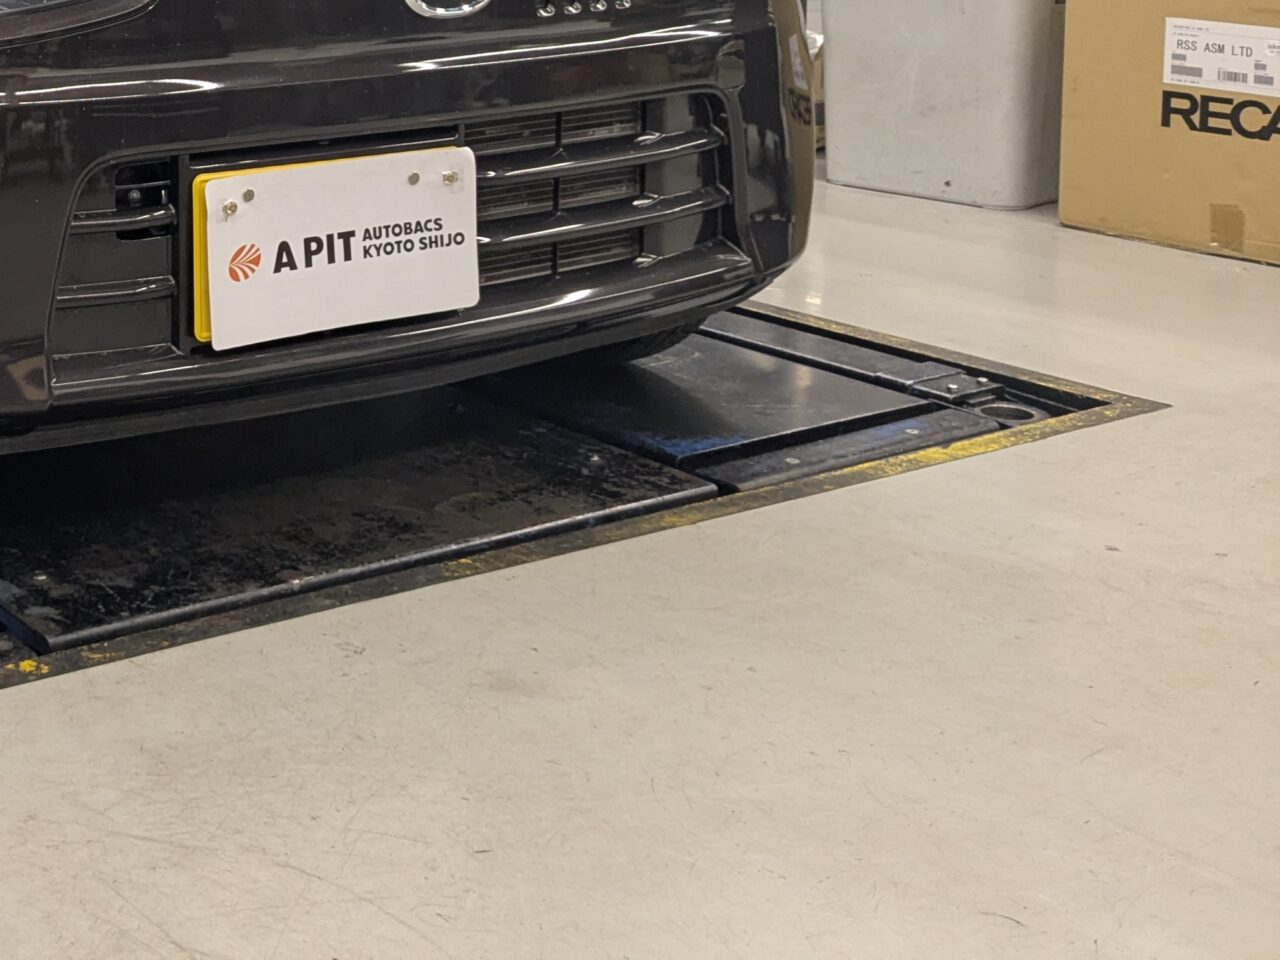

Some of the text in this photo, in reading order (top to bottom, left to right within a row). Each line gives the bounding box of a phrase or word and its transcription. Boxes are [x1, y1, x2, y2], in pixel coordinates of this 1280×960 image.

[1176, 39, 1198, 52] RSS
[1203, 42, 1225, 55] ASM
[1231, 45, 1253, 58] LTD
[362, 217, 443, 242] AUTOBACS
[303, 230, 356, 268] PIT
[362, 232, 465, 259] KYOTO SHIJO
